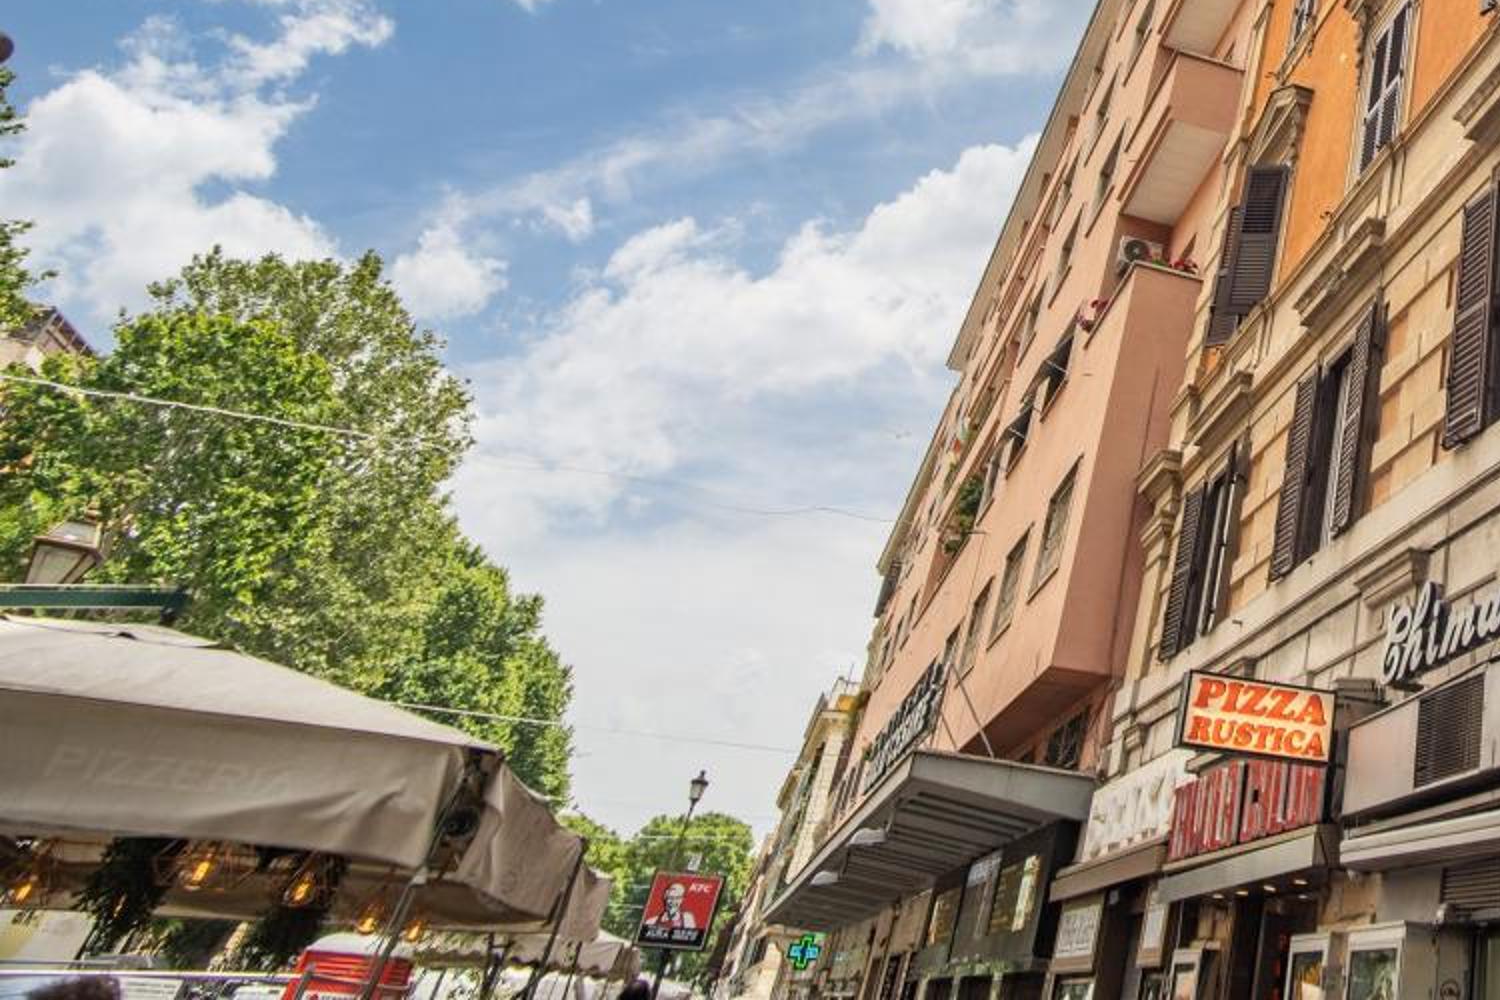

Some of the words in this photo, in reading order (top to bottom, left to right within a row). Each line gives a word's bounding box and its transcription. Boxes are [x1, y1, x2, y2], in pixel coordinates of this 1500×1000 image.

[1192, 677, 1327, 726] PIZZA
[1188, 715, 1325, 757] RUSTICA
[688, 882, 714, 893] KFC
